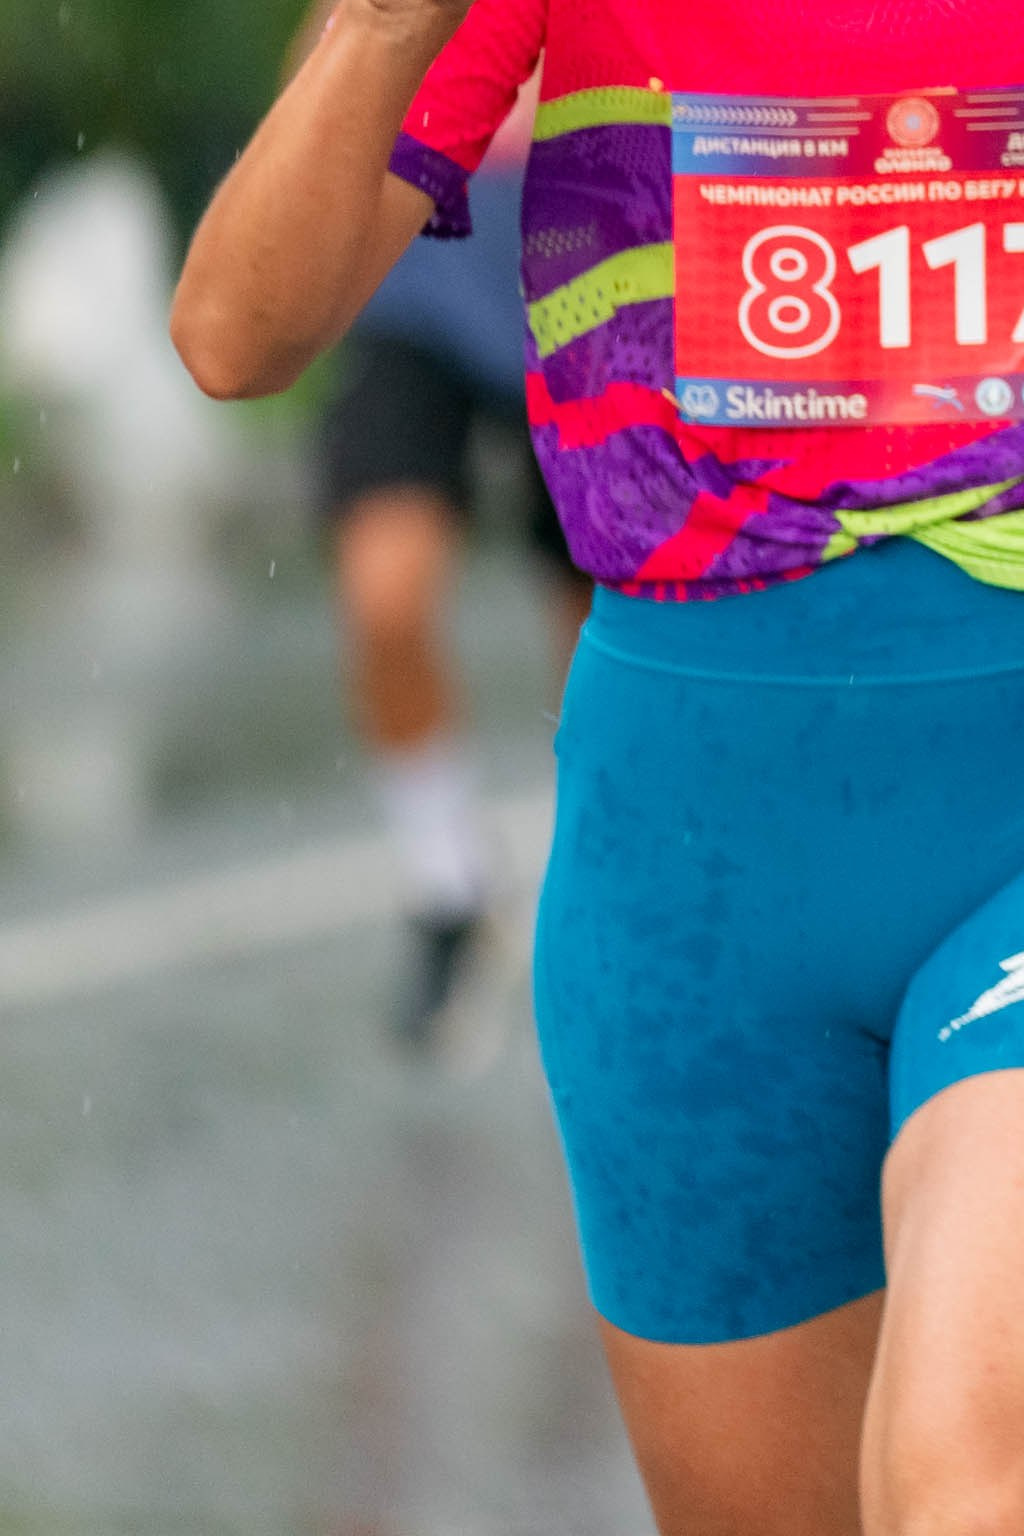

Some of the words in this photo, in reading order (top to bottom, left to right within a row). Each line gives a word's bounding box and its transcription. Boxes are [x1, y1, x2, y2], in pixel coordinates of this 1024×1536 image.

[692, 135, 801, 159] ДИСТАНЦИЯ
[817, 139, 848, 157] КМ
[700, 183, 833, 207] ЧЕМПИОНАТ
[836, 181, 926, 205] РОССИИ
[927, 180, 962, 202] ПО
[964, 178, 1016, 201] БЕГУ
[725, 385, 868, 419] Skintime
